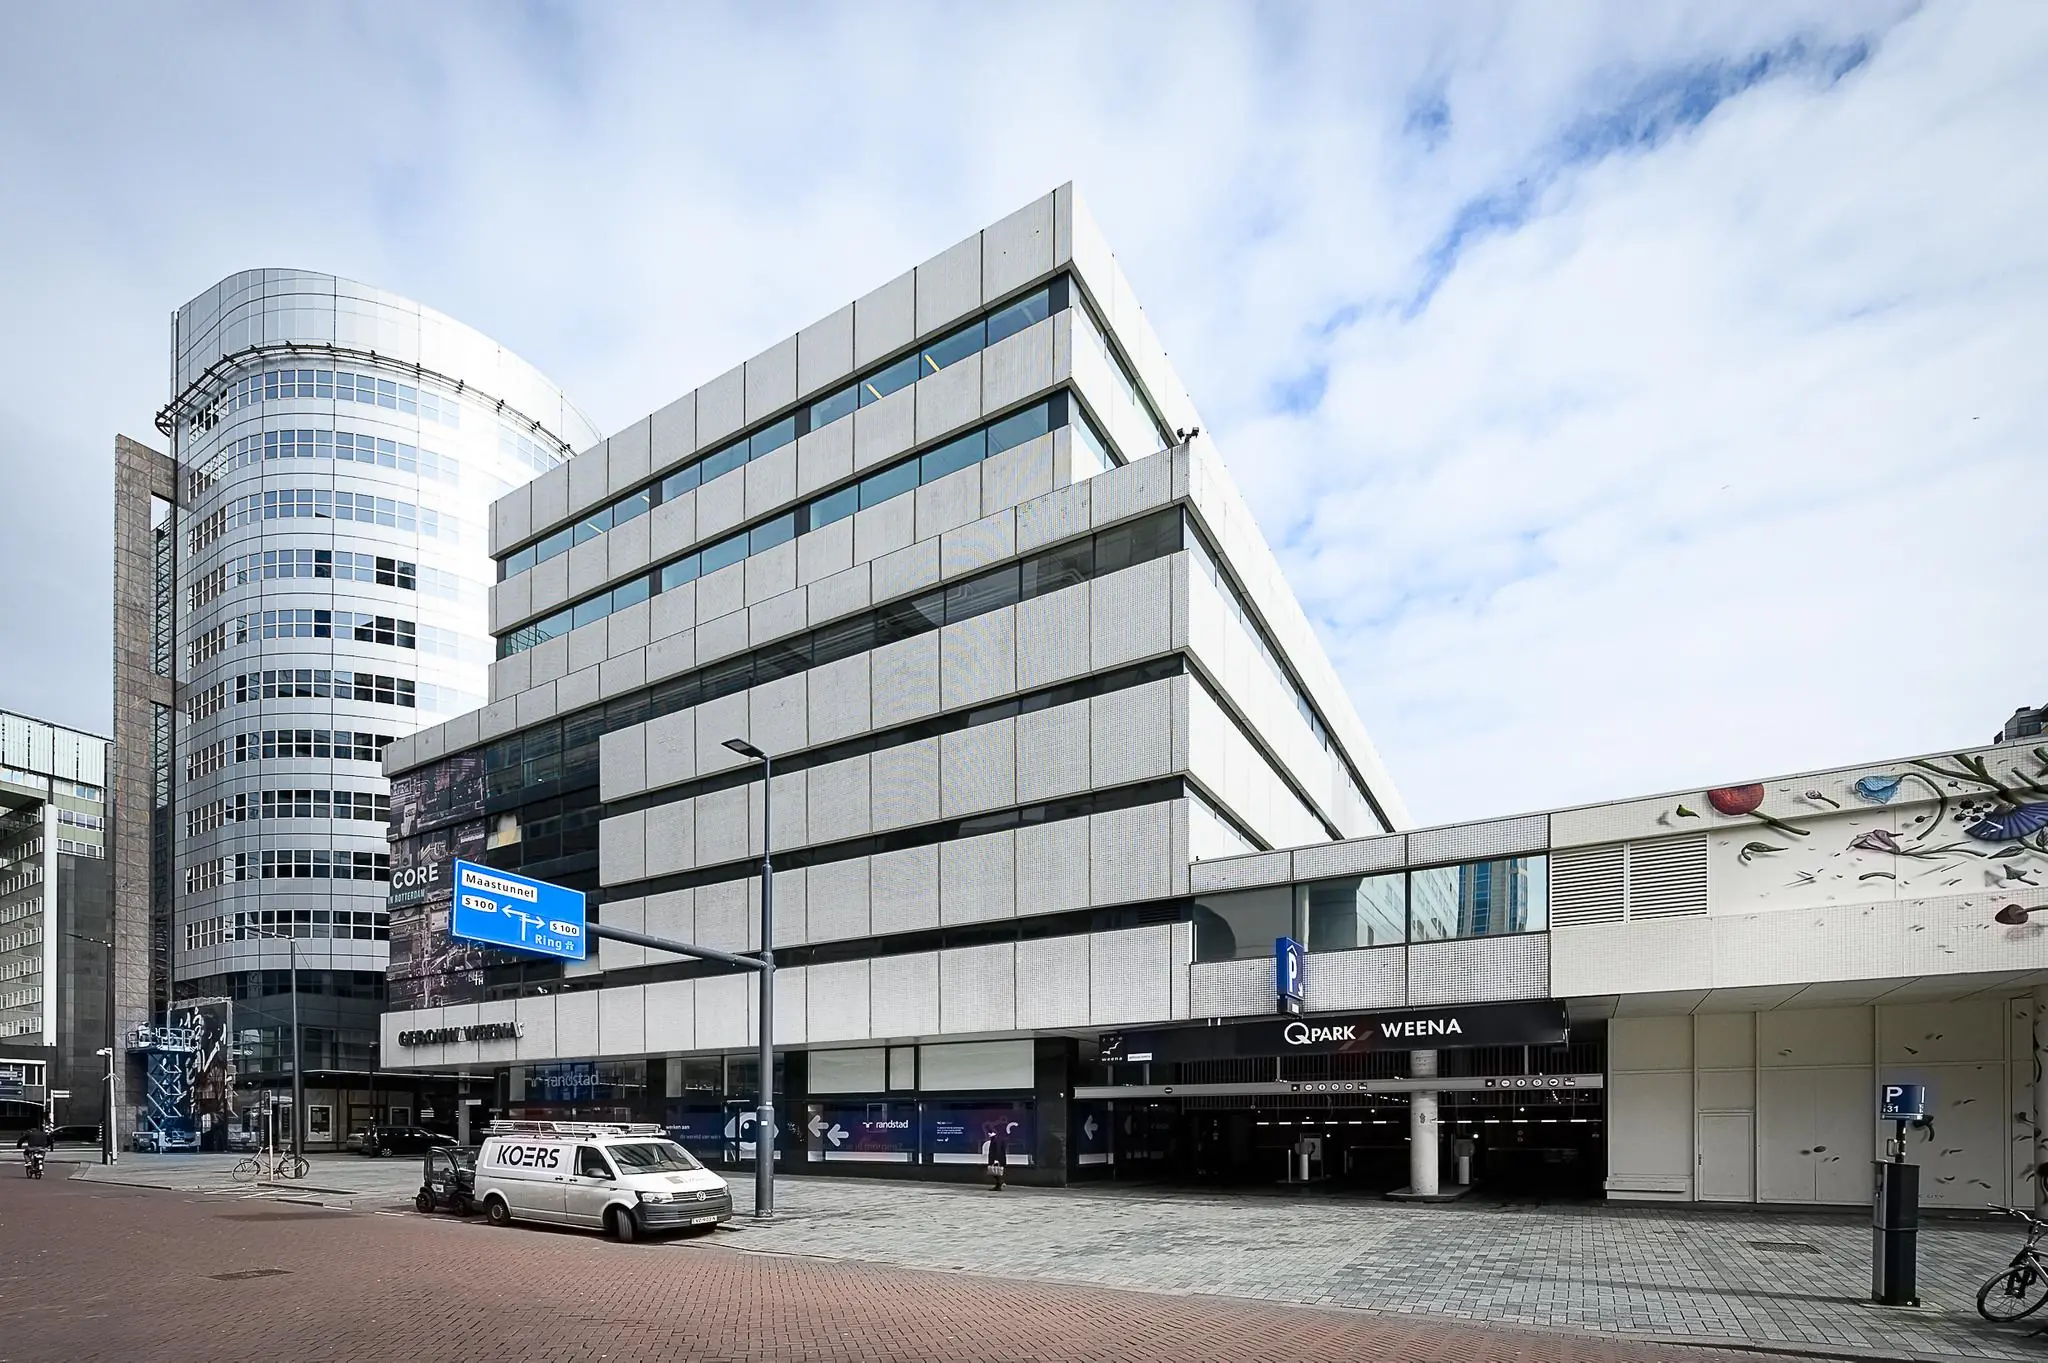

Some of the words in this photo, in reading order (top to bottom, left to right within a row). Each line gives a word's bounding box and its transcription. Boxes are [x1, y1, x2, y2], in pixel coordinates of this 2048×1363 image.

[393, 862, 439, 889] CORE
[466, 873, 534, 899] Maastunnel
[395, 889, 426, 903] ROTTERDAM
[465, 897, 471, 905] S
[474, 899, 494, 911] 100
[561, 925, 577, 935] 100
[535, 934, 562, 951] Ring
[398, 1027, 466, 1046] GEBOUW
[464, 1021, 524, 1041] WEENA
[1381, 1018, 1462, 1038] WEENA
[547, 1070, 599, 1087] randstad
[1886, 1086, 1903, 1103] P
[1886, 1105, 1899, 1113] 31
[876, 1120, 909, 1129] randstad
[496, 1145, 560, 1168] KOERS
